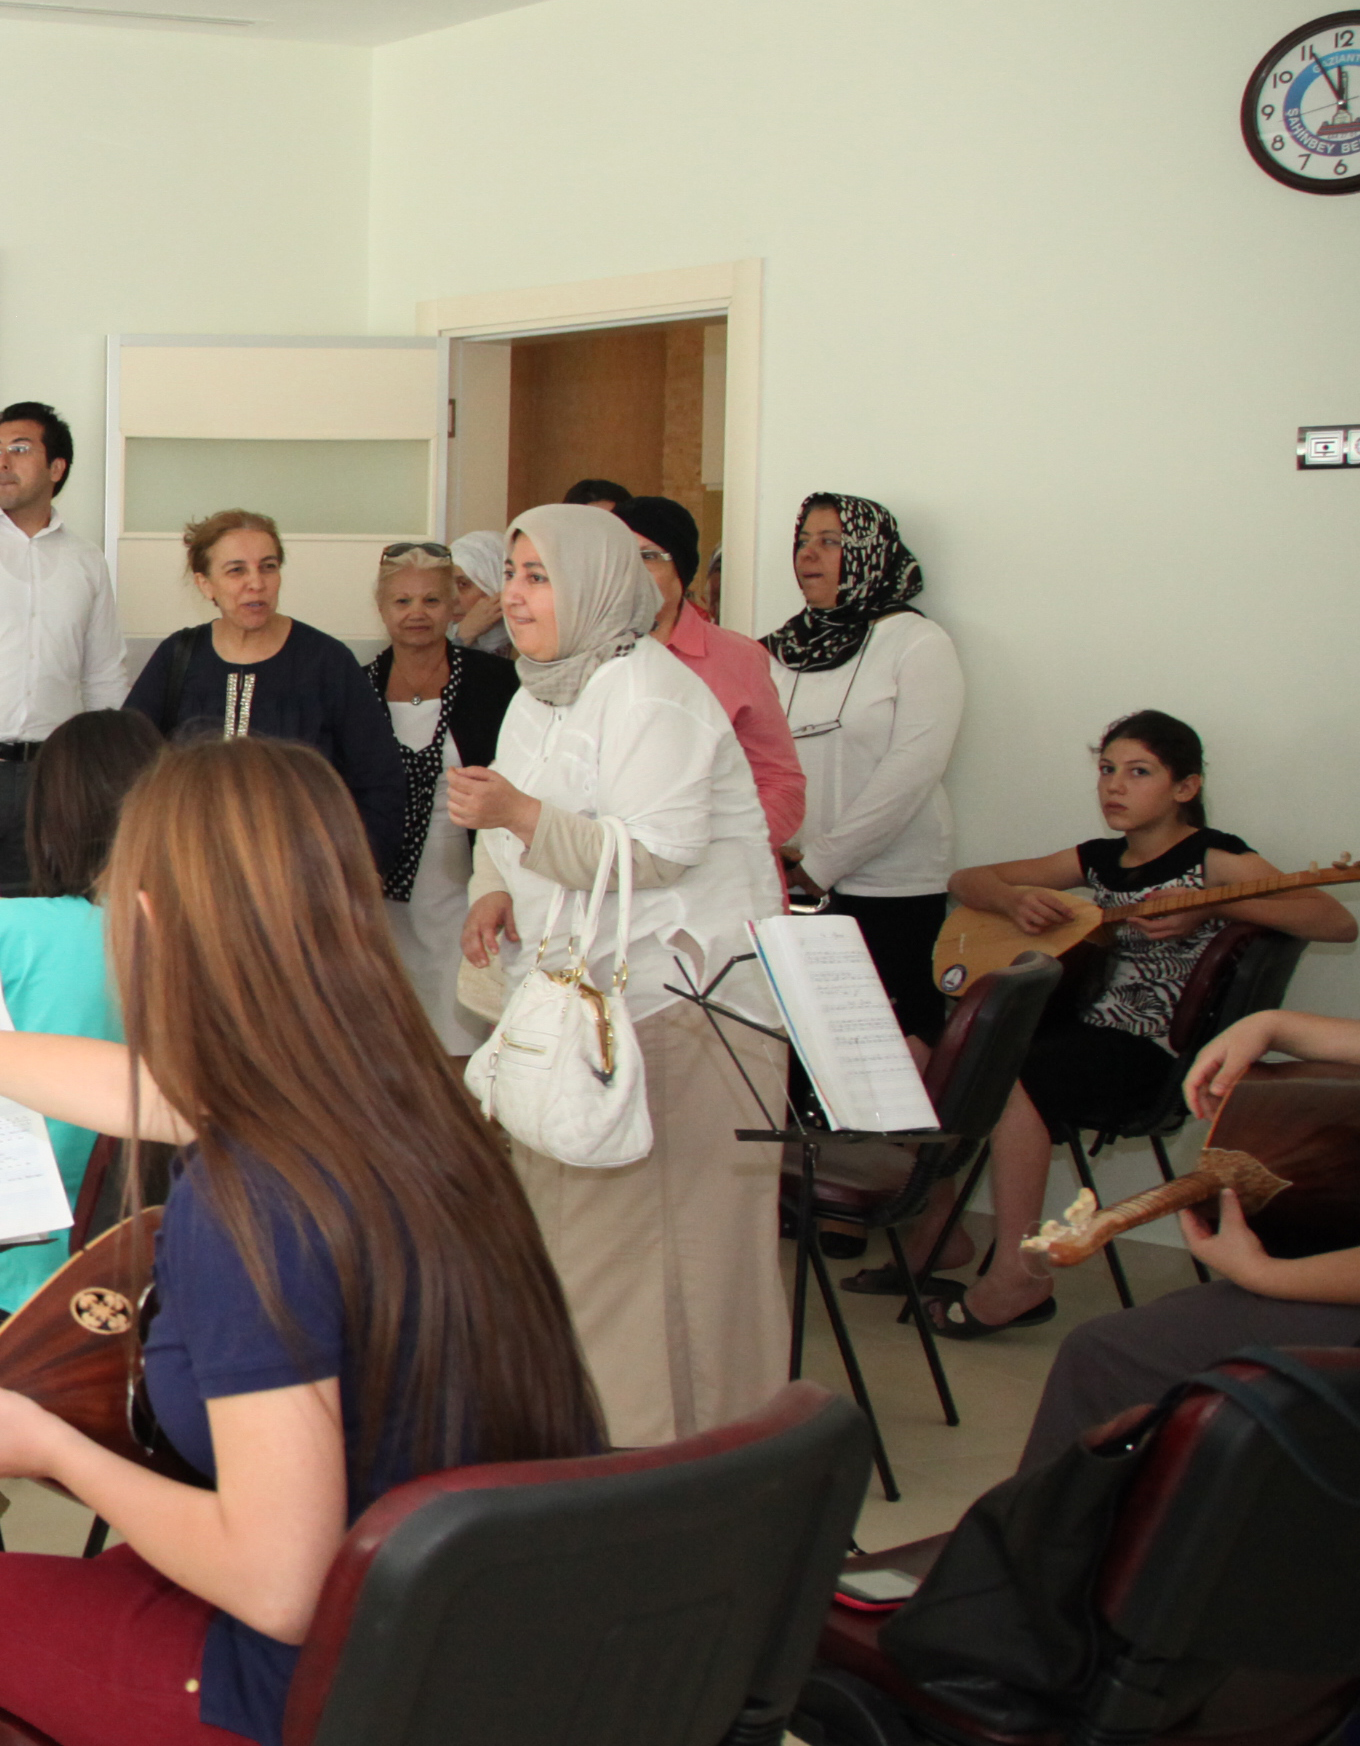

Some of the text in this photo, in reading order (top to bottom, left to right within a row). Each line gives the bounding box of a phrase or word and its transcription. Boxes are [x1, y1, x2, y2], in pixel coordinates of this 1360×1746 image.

[1334, 30, 1354, 48] 12
[1301, 44, 1314, 61] 11
[1273, 71, 1293, 89] 10
[1261, 104, 1275, 120] 9
[1271, 134, 1285, 151] 8
[1298, 153, 1312, 170] 7
[1333, 159, 1348, 175] 6
